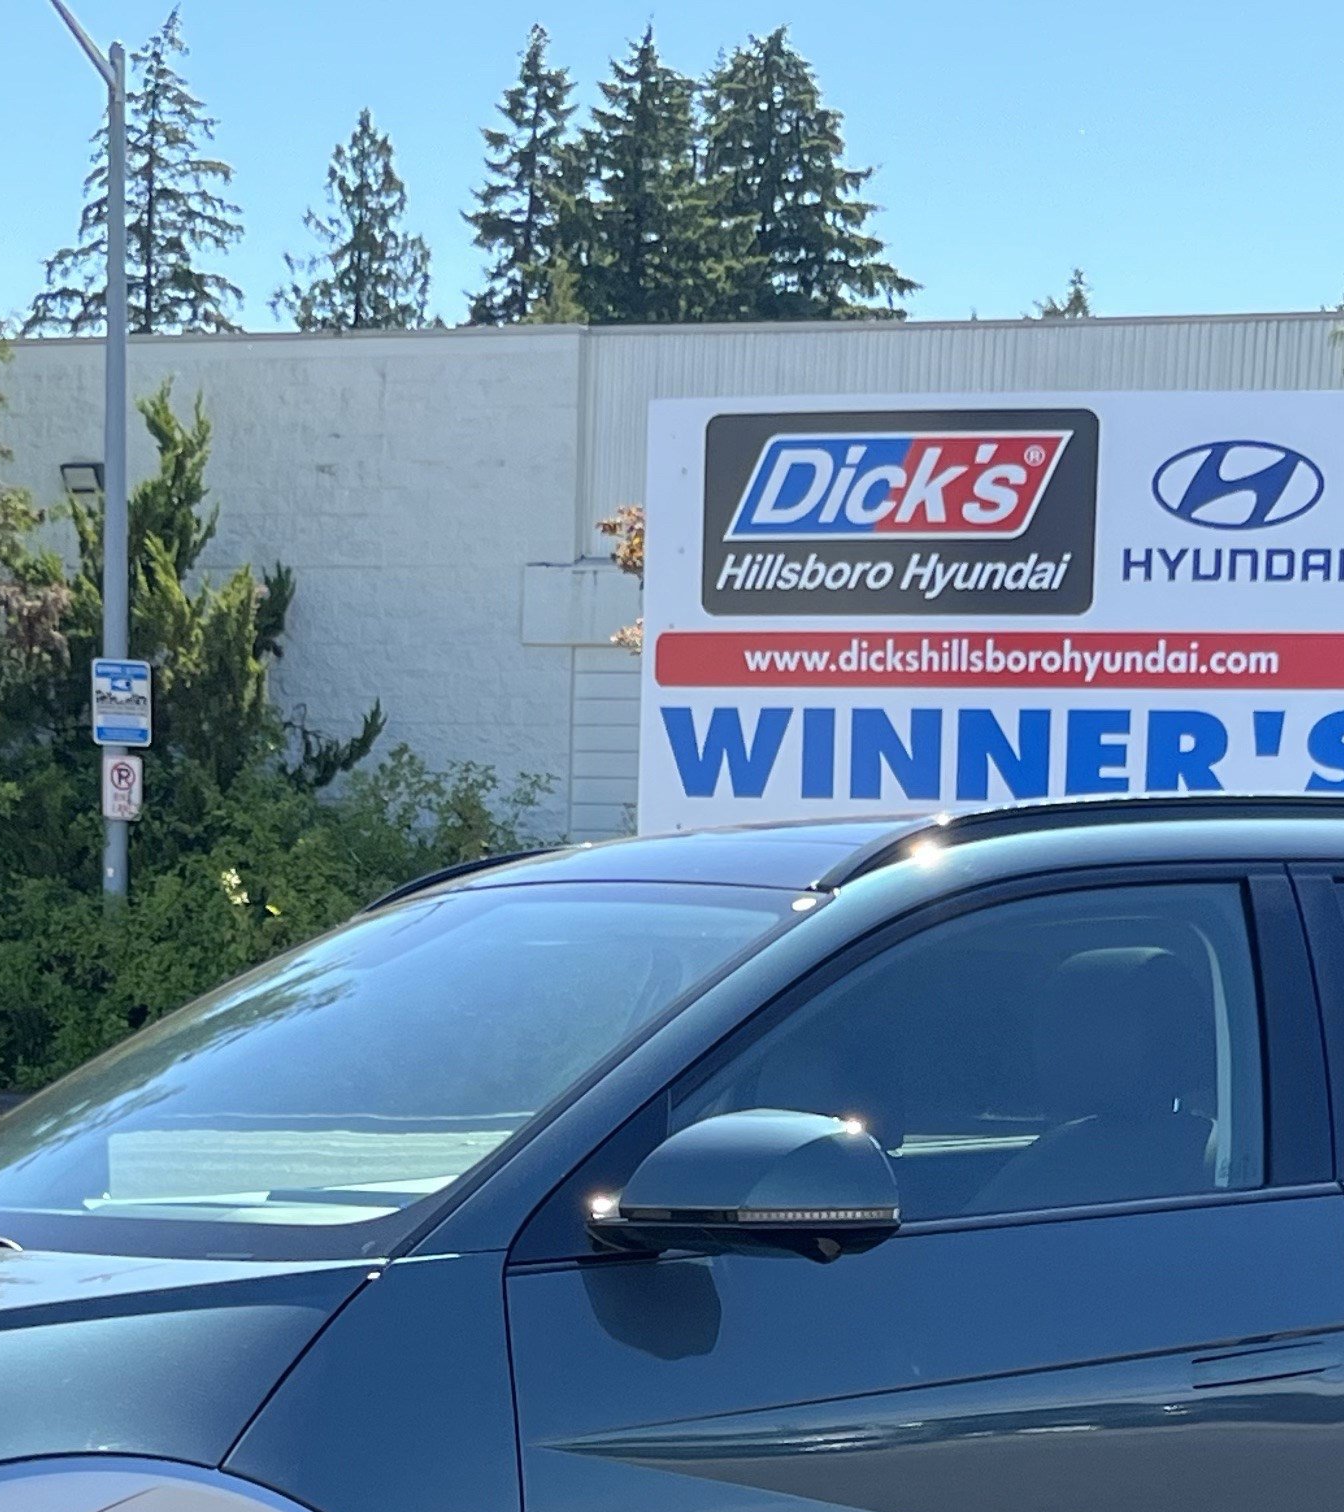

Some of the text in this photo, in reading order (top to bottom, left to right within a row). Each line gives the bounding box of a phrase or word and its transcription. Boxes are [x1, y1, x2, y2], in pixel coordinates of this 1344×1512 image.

[716, 552, 1072, 600] Hillsboro Hyundai
[744, 640, 1280, 681] www.dickshillsborohyundai.com
